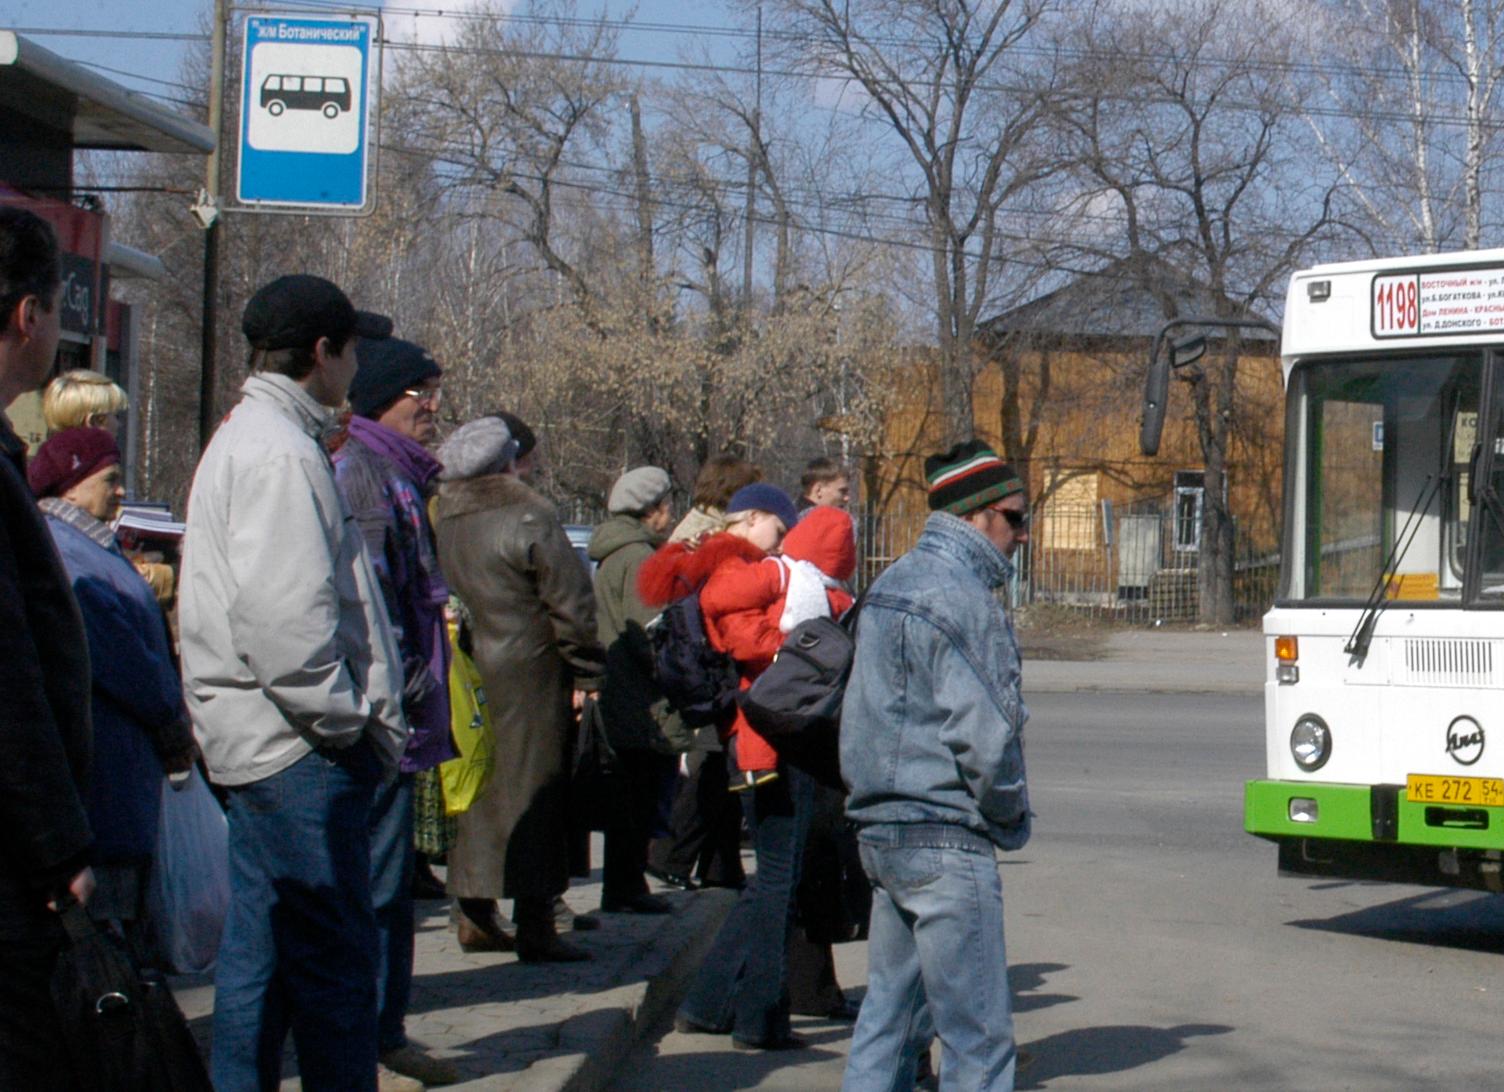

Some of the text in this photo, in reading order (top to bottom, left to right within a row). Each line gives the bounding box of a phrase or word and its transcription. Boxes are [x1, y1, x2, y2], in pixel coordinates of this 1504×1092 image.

[278, 23, 366, 40] Ботанический"
[1421, 278, 1467, 289] ВОСТОЧНЫЙ
[1377, 281, 1417, 330] 1198
[1438, 306, 1468, 316] ЛЕНИНА
[1414, 780, 1498, 801] КЕ 272 54
